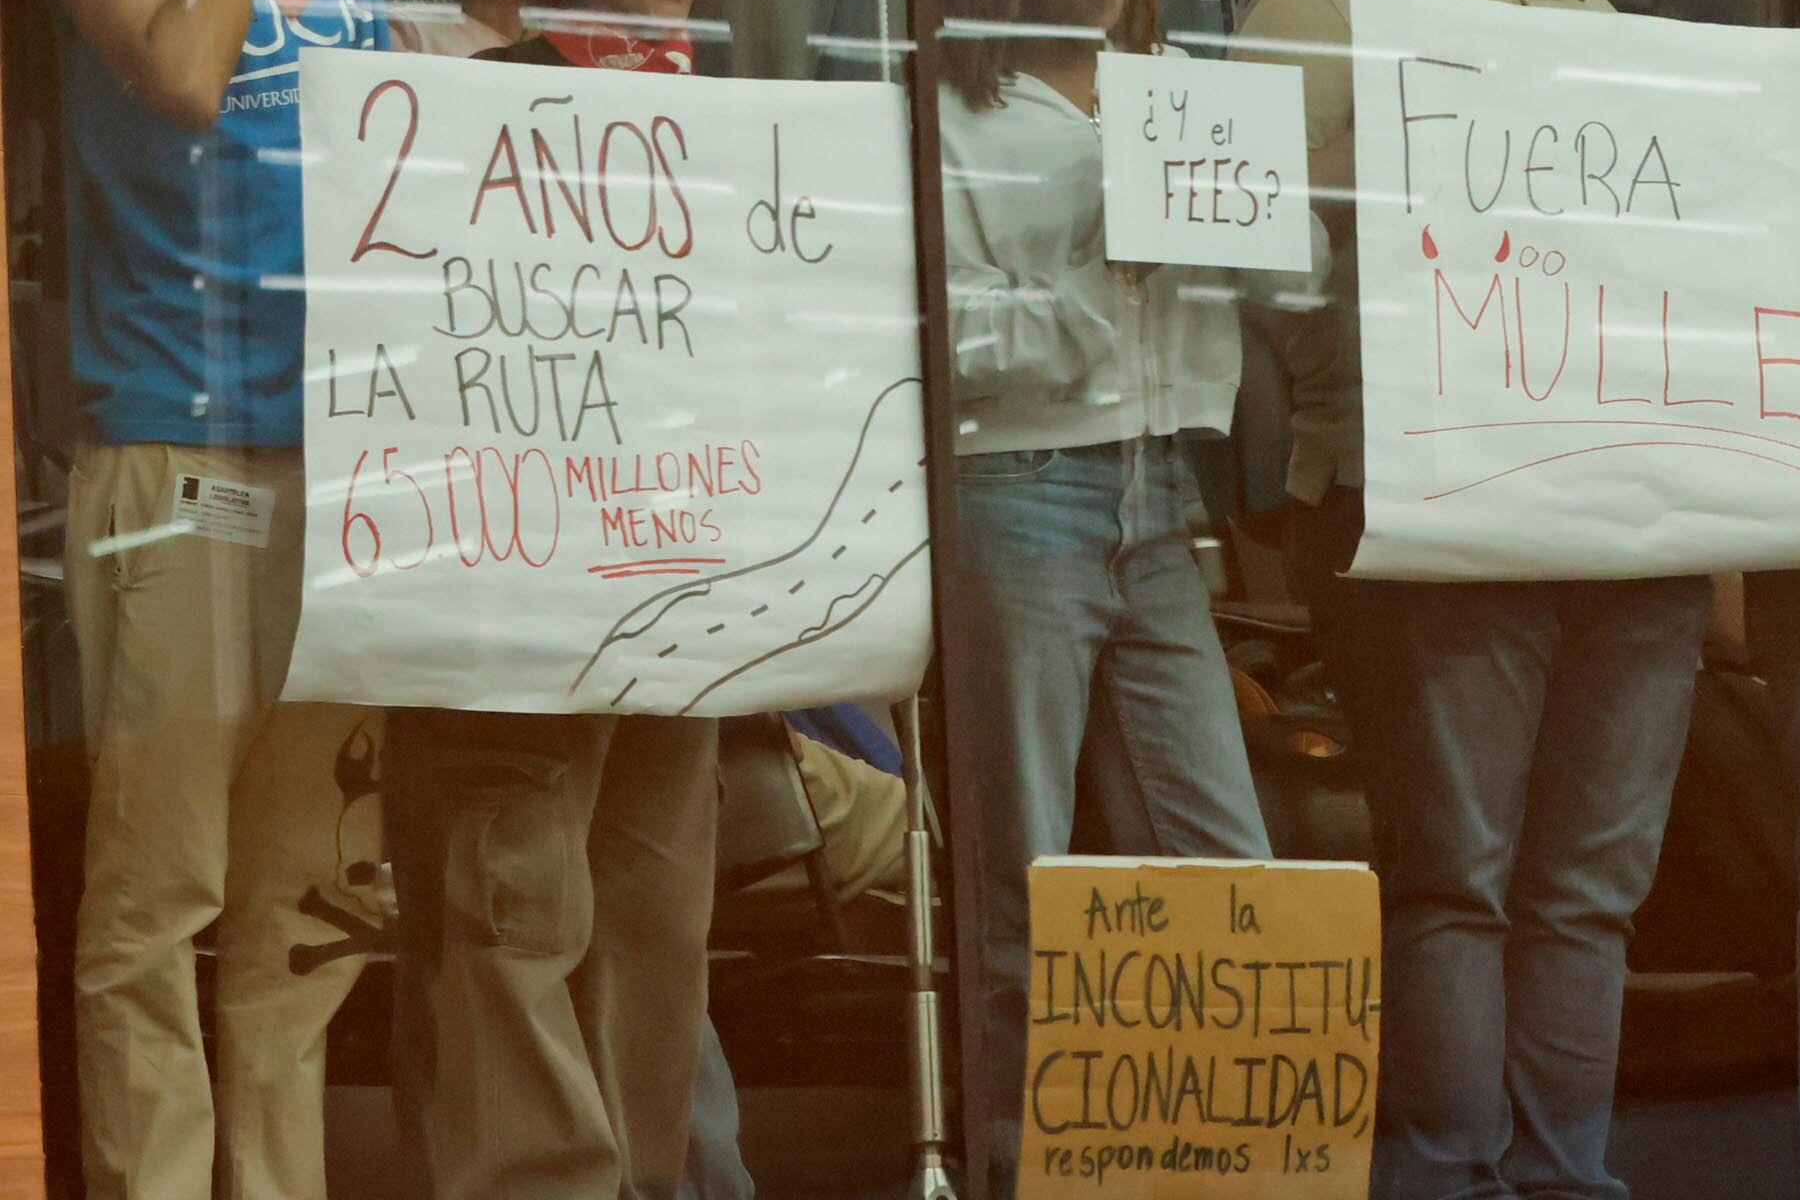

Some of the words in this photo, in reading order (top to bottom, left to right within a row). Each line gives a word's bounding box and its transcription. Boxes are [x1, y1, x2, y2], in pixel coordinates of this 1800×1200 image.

[1142, 89, 1188, 143] ¿Y
[1210, 118, 1233, 146] el
[1397, 56, 1681, 221] FUERA
[351, 78, 439, 263] 2
[469, 94, 694, 259] AÑOS
[745, 122, 834, 264] de
[1162, 157, 1280, 227] FEES?
[432, 256, 695, 358] BUSCAR
[327, 343, 416, 421] LA
[453, 344, 623, 446] RUTA
[565, 439, 762, 500] MILLONES
[599, 506, 722, 550] MENOS
[1083, 880, 1170, 940] Ante
[1229, 883, 1262, 935] la
[1032, 1045, 1370, 1139] CIONALIDAD,
[1044, 1134, 1251, 1186] respondemos
[1282, 1133, 1331, 1175] lxs
